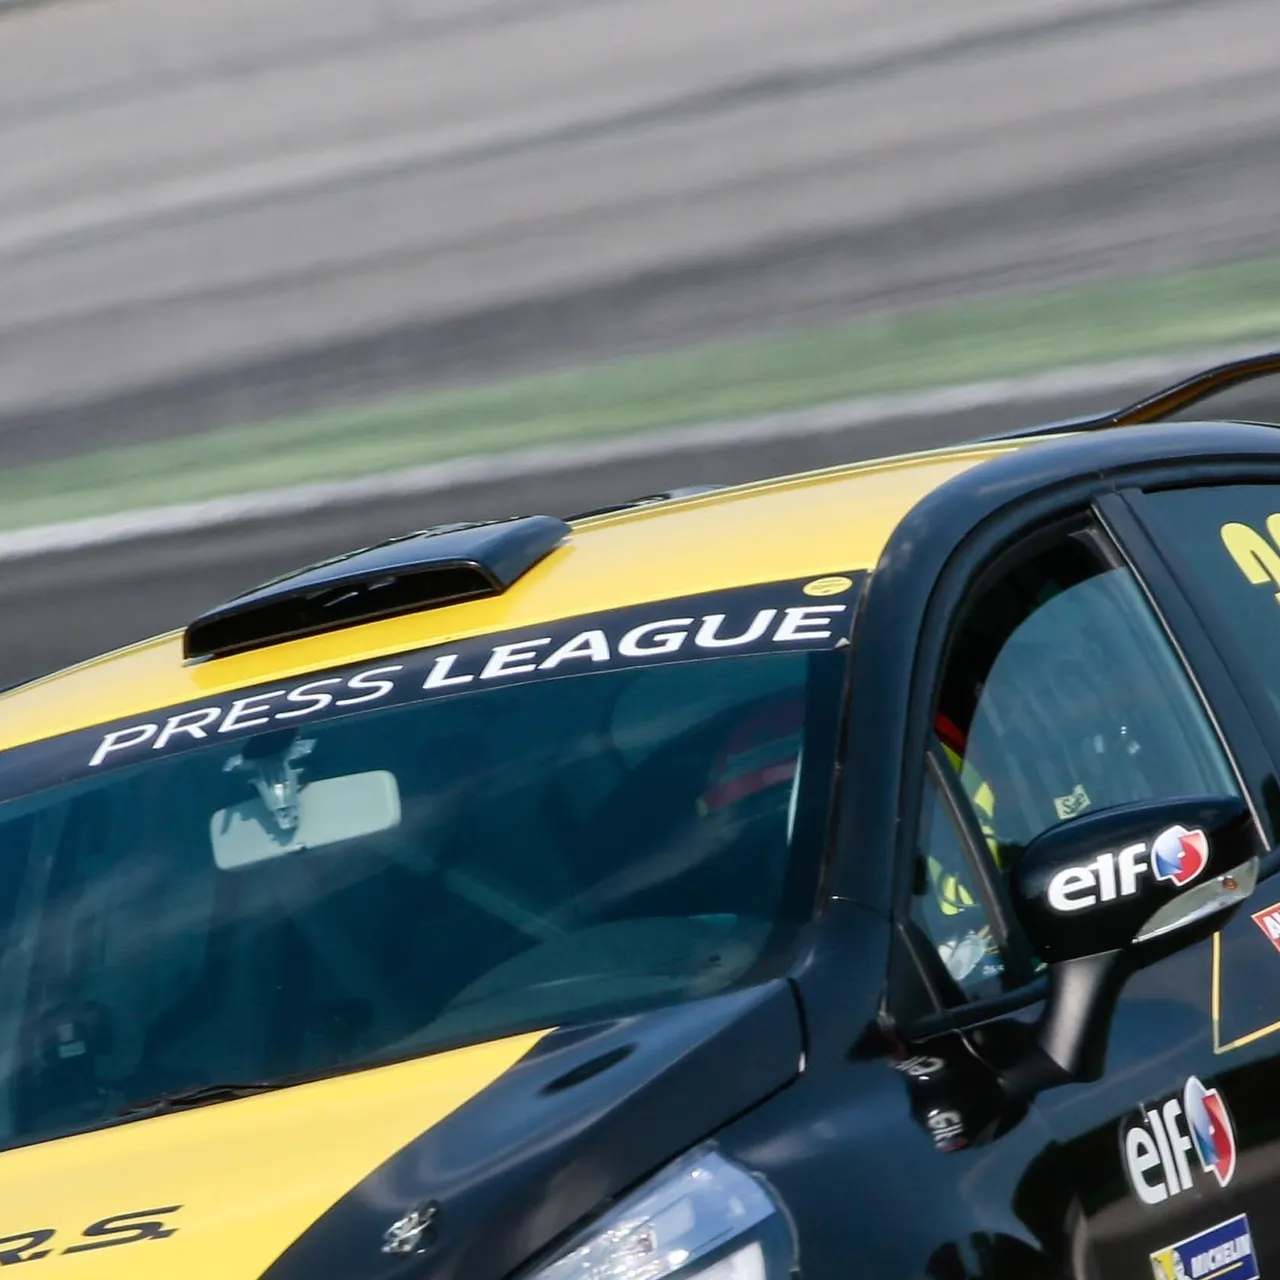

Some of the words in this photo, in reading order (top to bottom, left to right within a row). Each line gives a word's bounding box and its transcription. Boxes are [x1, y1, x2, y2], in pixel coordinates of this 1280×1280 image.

[89, 664, 396, 769] PRESS
[420, 604, 848, 691] LEAGUE
[1047, 842, 1148, 913] elf
[1125, 1098, 1196, 1206] elf
[1191, 1234, 1252, 1279] MICHELIN
